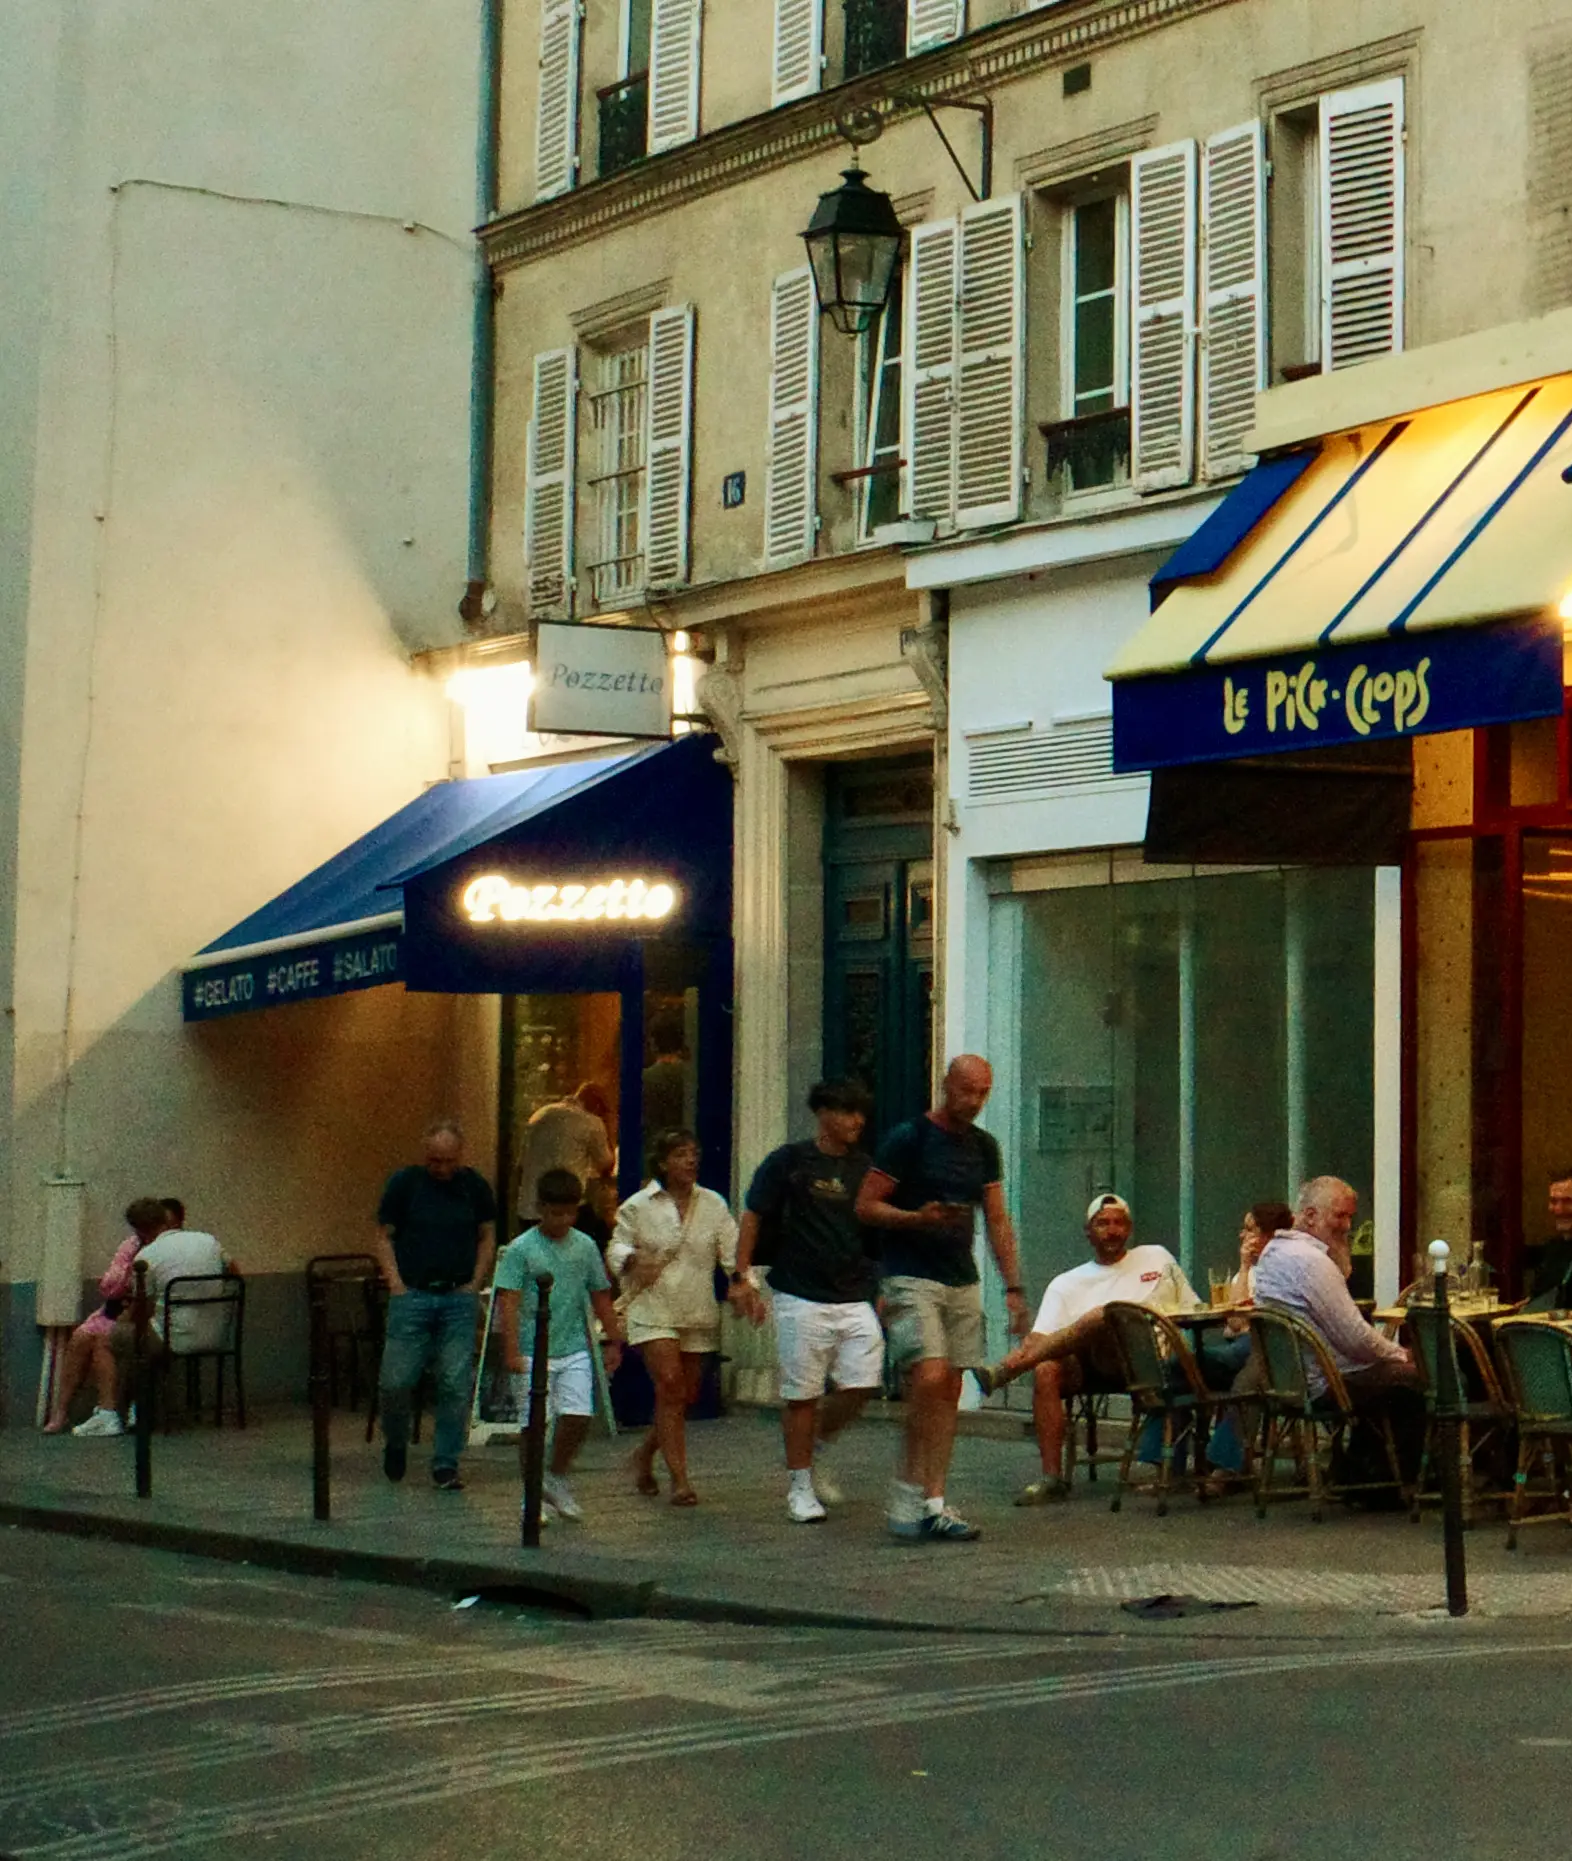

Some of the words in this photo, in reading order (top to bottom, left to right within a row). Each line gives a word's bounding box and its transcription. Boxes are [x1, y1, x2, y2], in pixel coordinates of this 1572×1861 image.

[550, 662, 664, 696] Pozzetto
[1223, 676, 1249, 735] LE
[463, 874, 674, 922] Pozzetto
[193, 973, 255, 1008] #GELATO
[266, 959, 320, 995] #CAFFE
[332, 942, 398, 983] #SALATO
